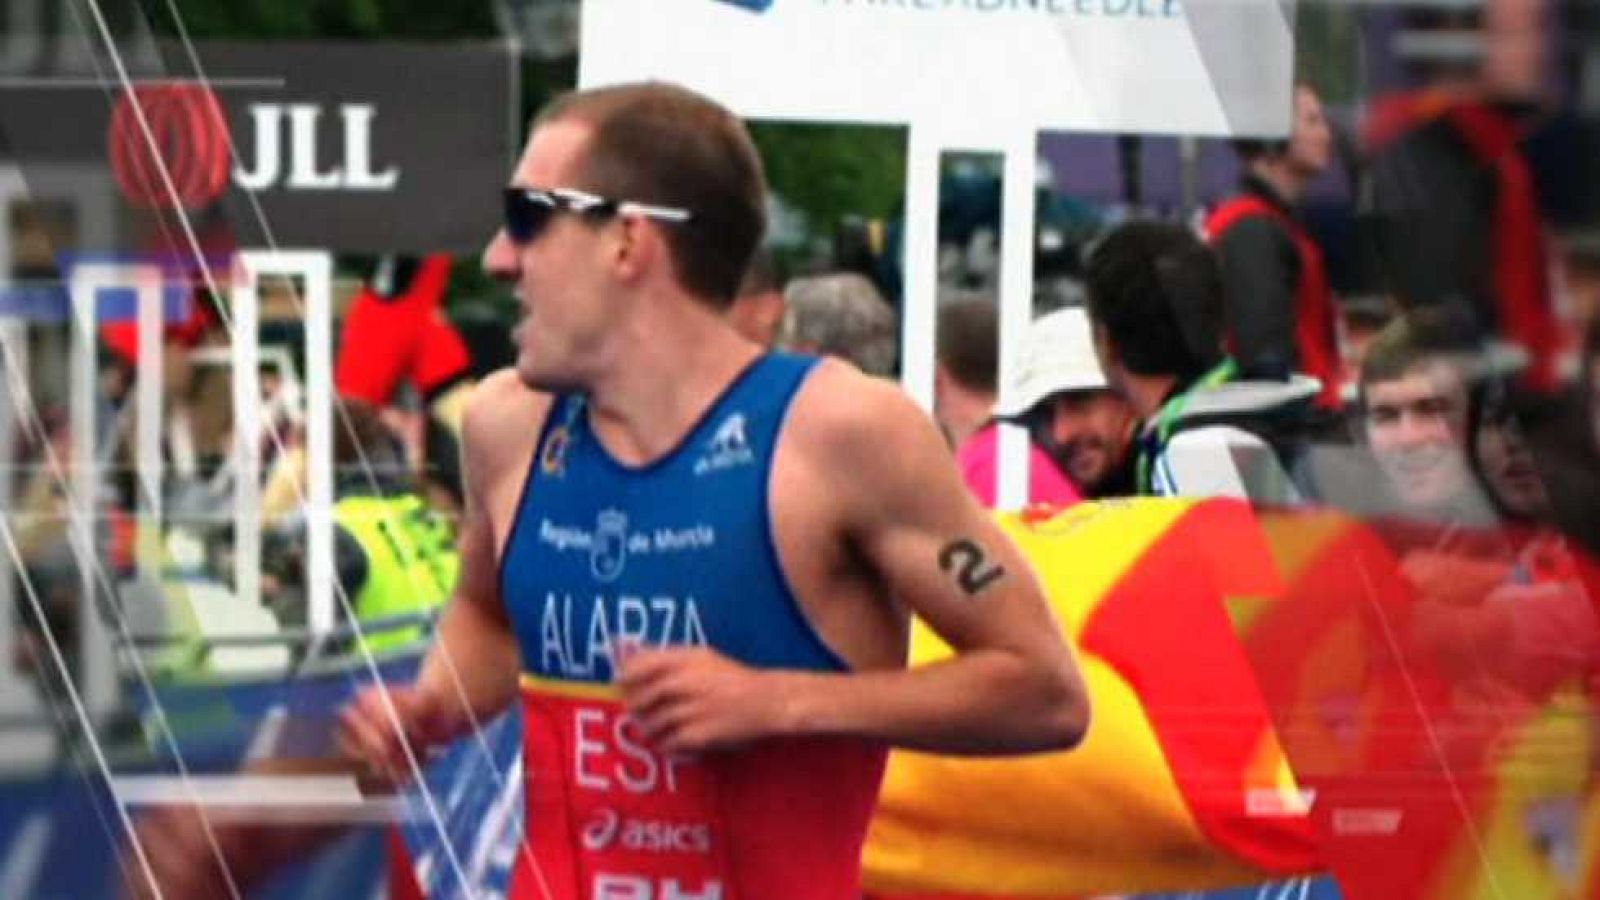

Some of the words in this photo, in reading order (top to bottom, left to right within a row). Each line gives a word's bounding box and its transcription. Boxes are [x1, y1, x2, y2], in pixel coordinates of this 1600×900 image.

[230, 103, 398, 190] JLL
[938, 539, 1004, 595] 2
[541, 591, 709, 681] ALARZA
[621, 820, 711, 855] asics
